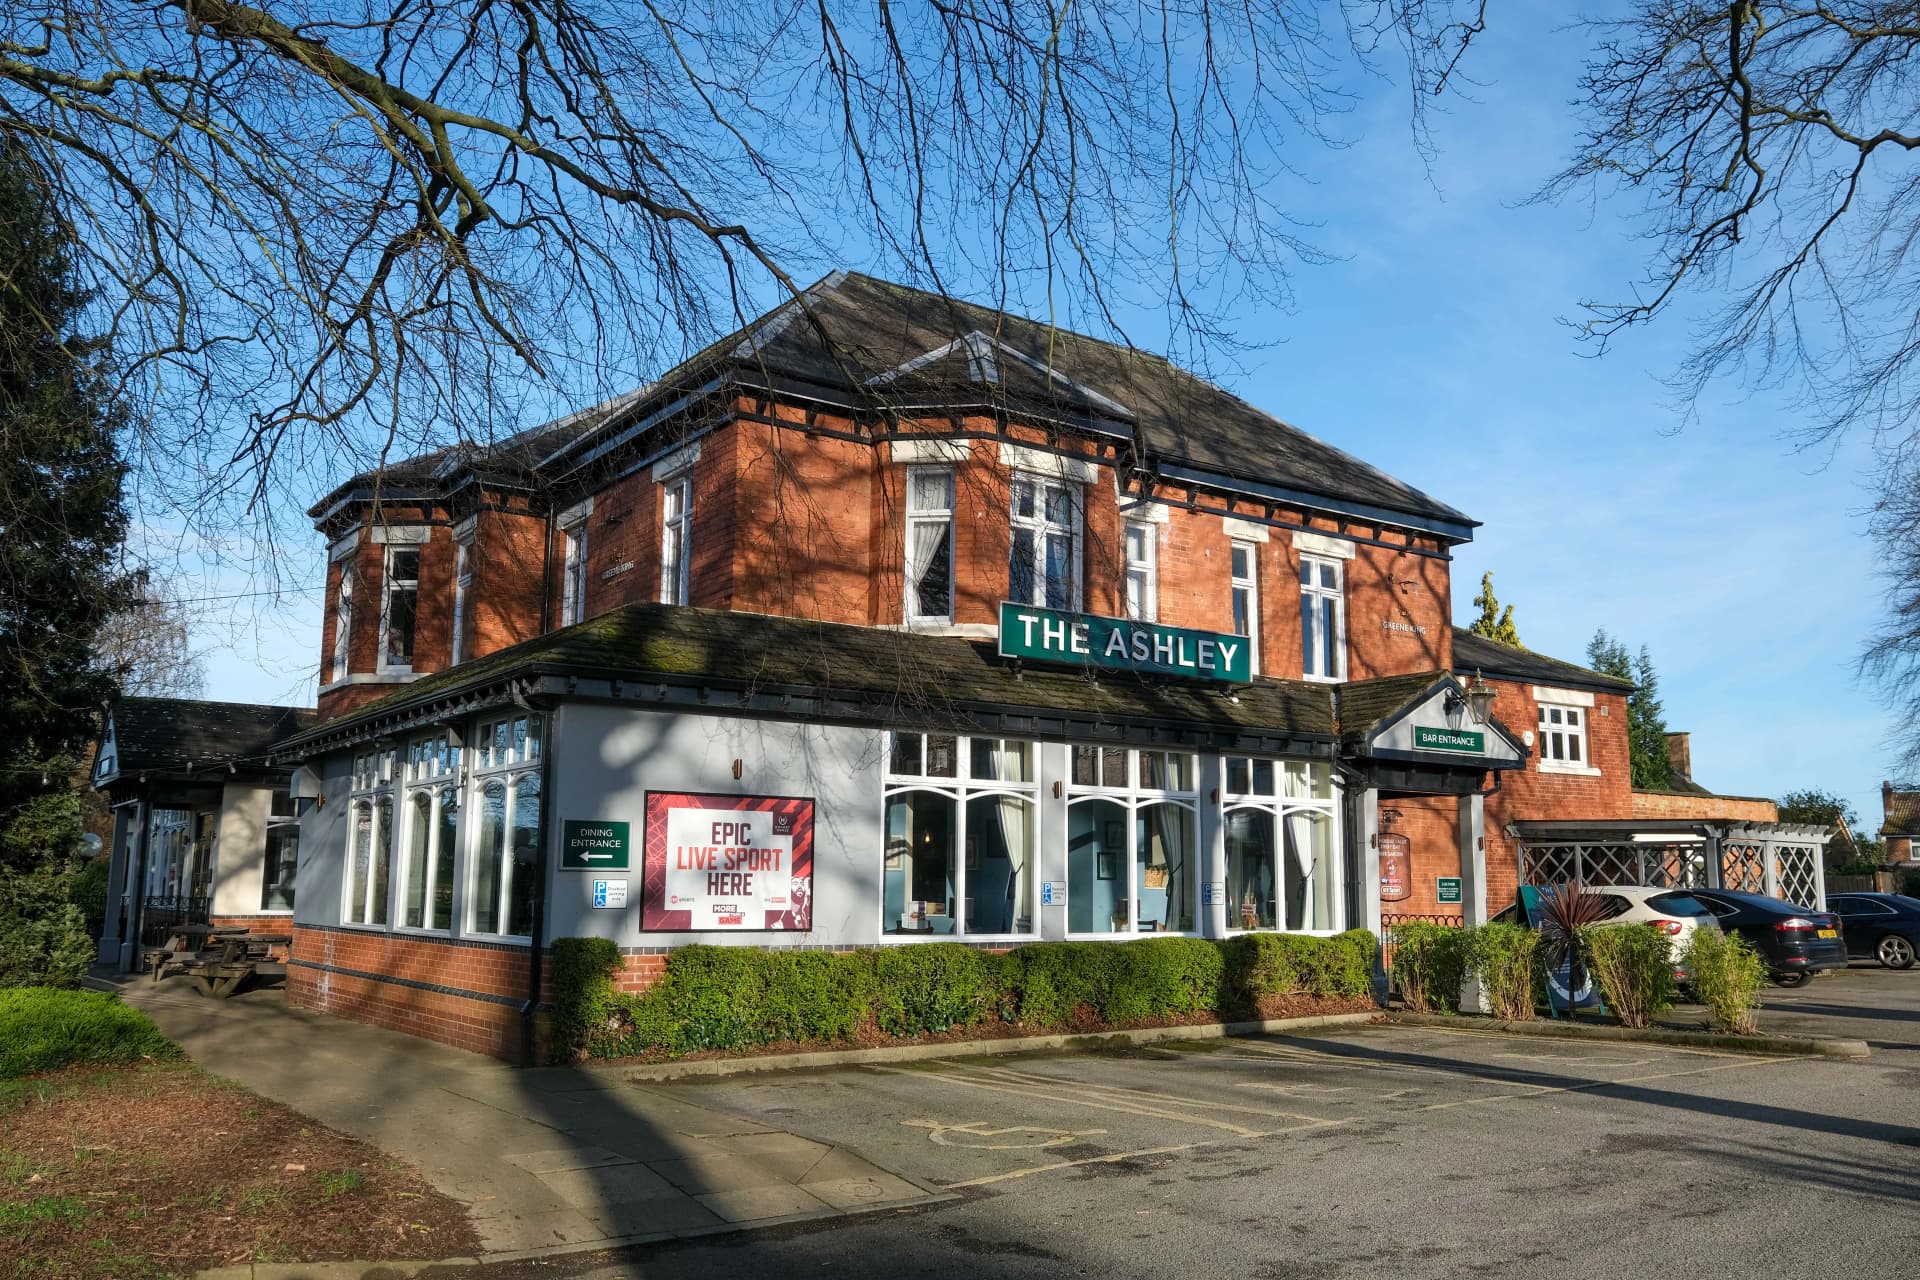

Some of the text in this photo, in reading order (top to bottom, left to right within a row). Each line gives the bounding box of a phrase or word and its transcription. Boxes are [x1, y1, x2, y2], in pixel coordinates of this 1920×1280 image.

[1382, 621, 1426, 635] GREENE KING
[1017, 614, 1238, 672] THE ASHLEY
[1422, 733, 1476, 747] BAR ENTRANCE
[580, 828, 613, 837] DINING
[711, 821, 752, 846] EPIC
[571, 838, 622, 848] ENTRANCE
[677, 845, 783, 872] LIVE SPORT
[597, 882, 606, 894] P
[706, 872, 753, 897] HERE
[713, 905, 737, 913] MORE
[718, 916, 742, 925] GAME
